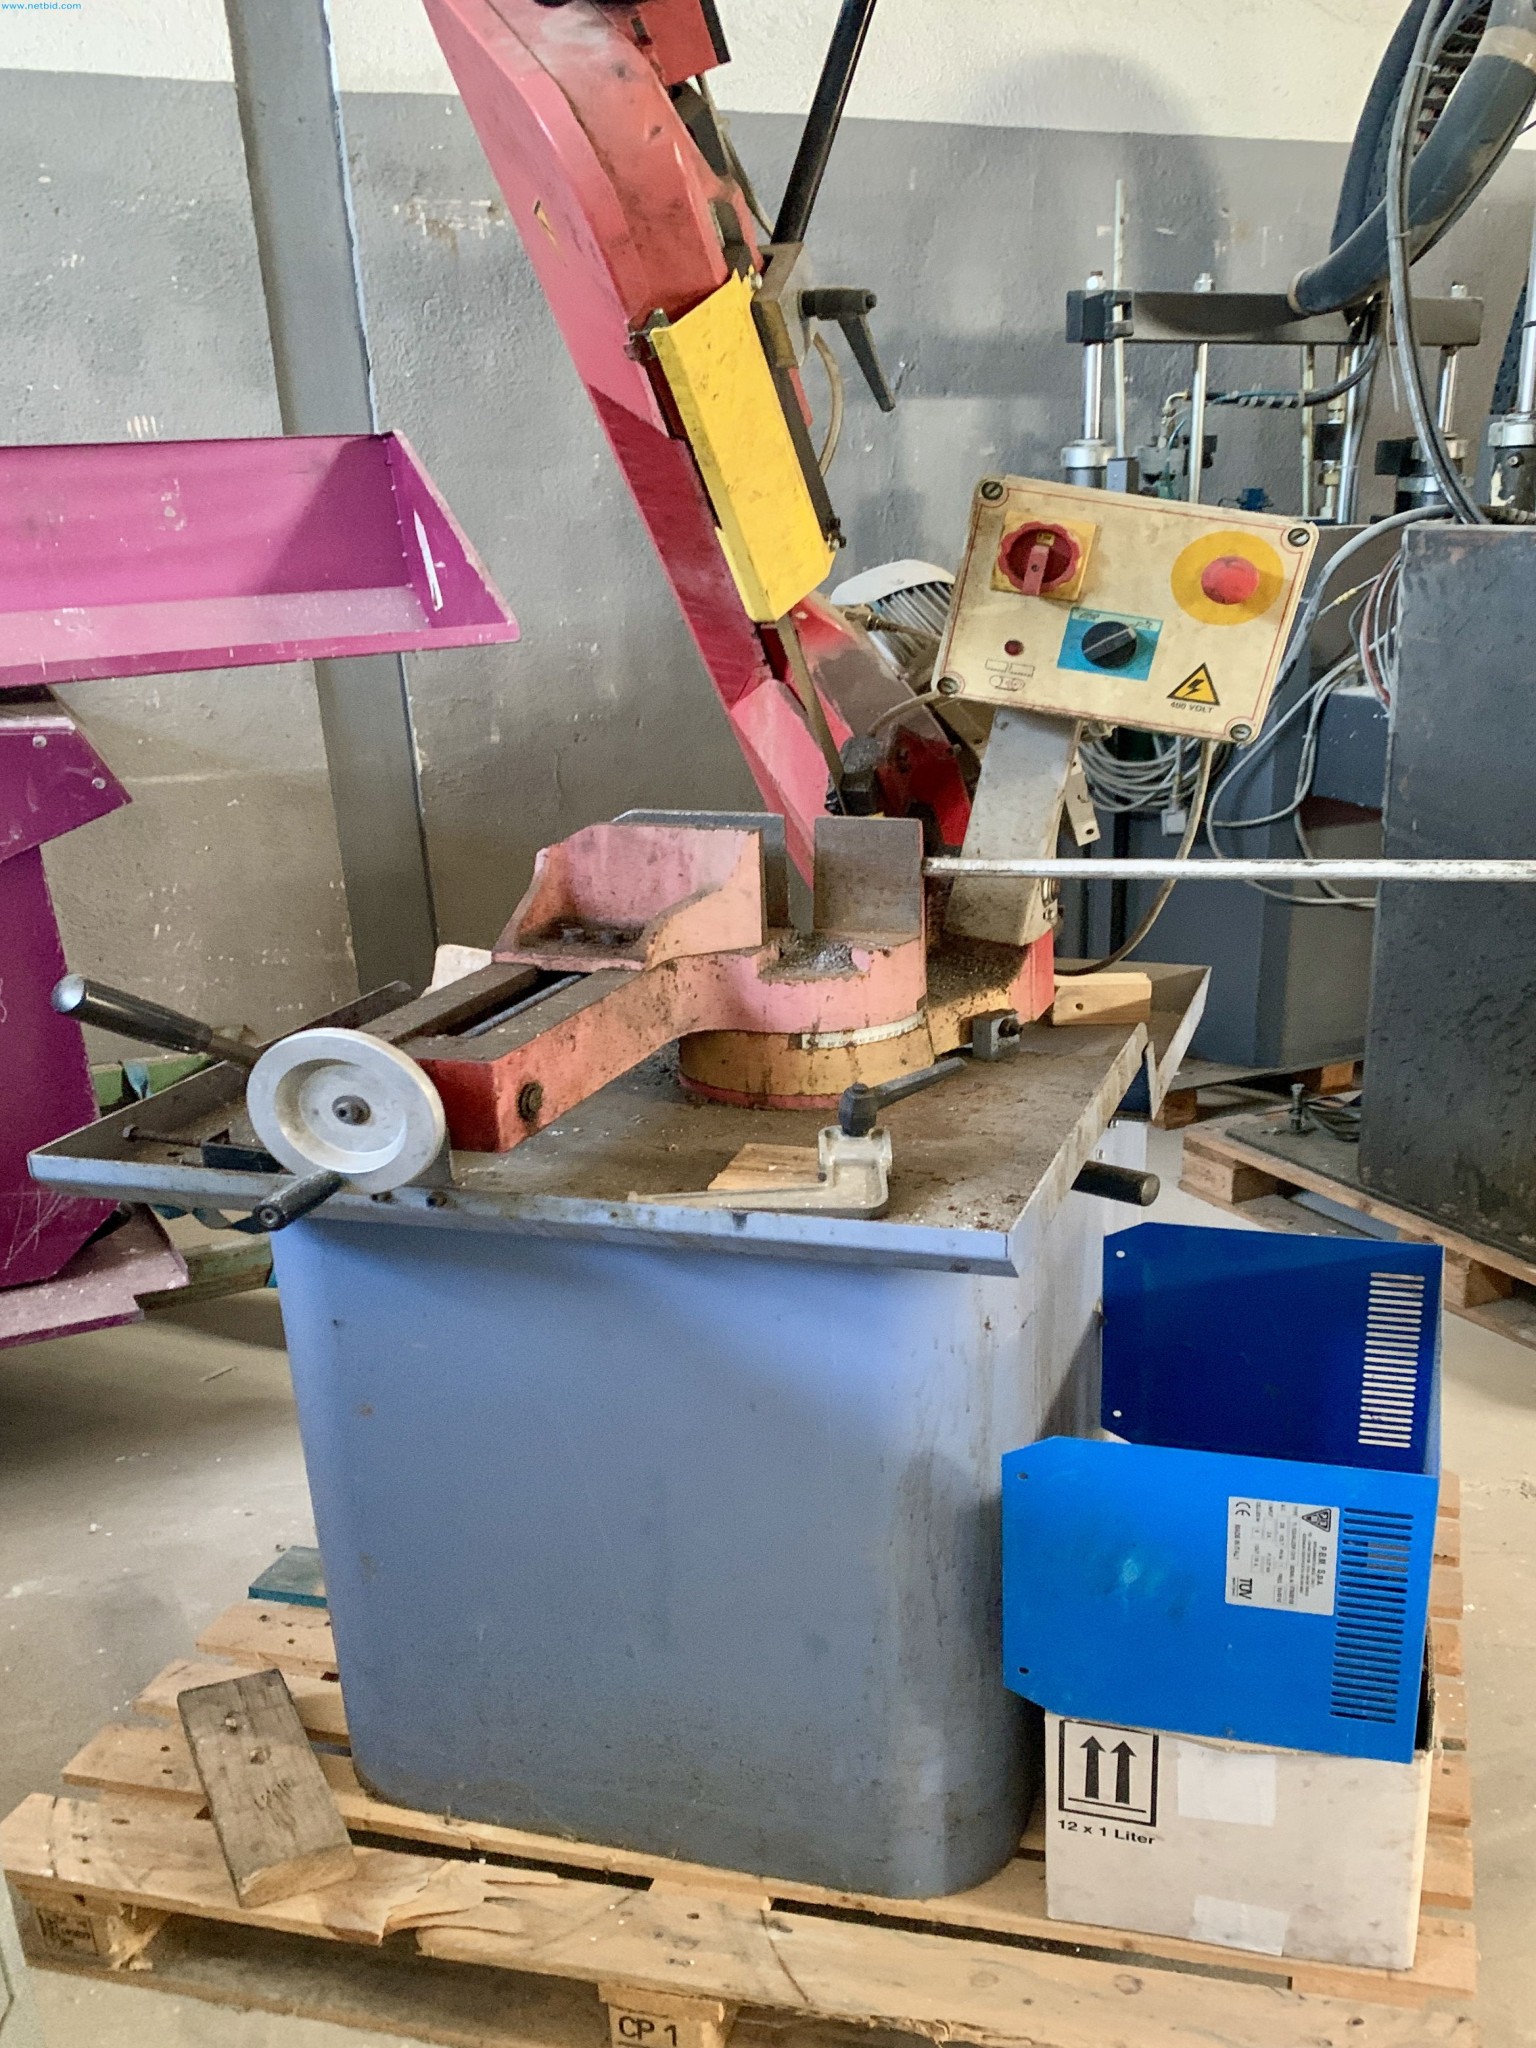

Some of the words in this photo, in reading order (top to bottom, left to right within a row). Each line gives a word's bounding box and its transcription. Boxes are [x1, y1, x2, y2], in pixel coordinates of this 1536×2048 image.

[1189, 704, 1214, 713] VOLT
[1058, 1820, 1078, 1832] 12
[1083, 1826, 1093, 1834] x
[1100, 1827, 1107, 1837] 1
[1115, 1829, 1155, 1845] Liter
[619, 2016, 655, 2040] CP
[664, 2024, 677, 2047] 1
